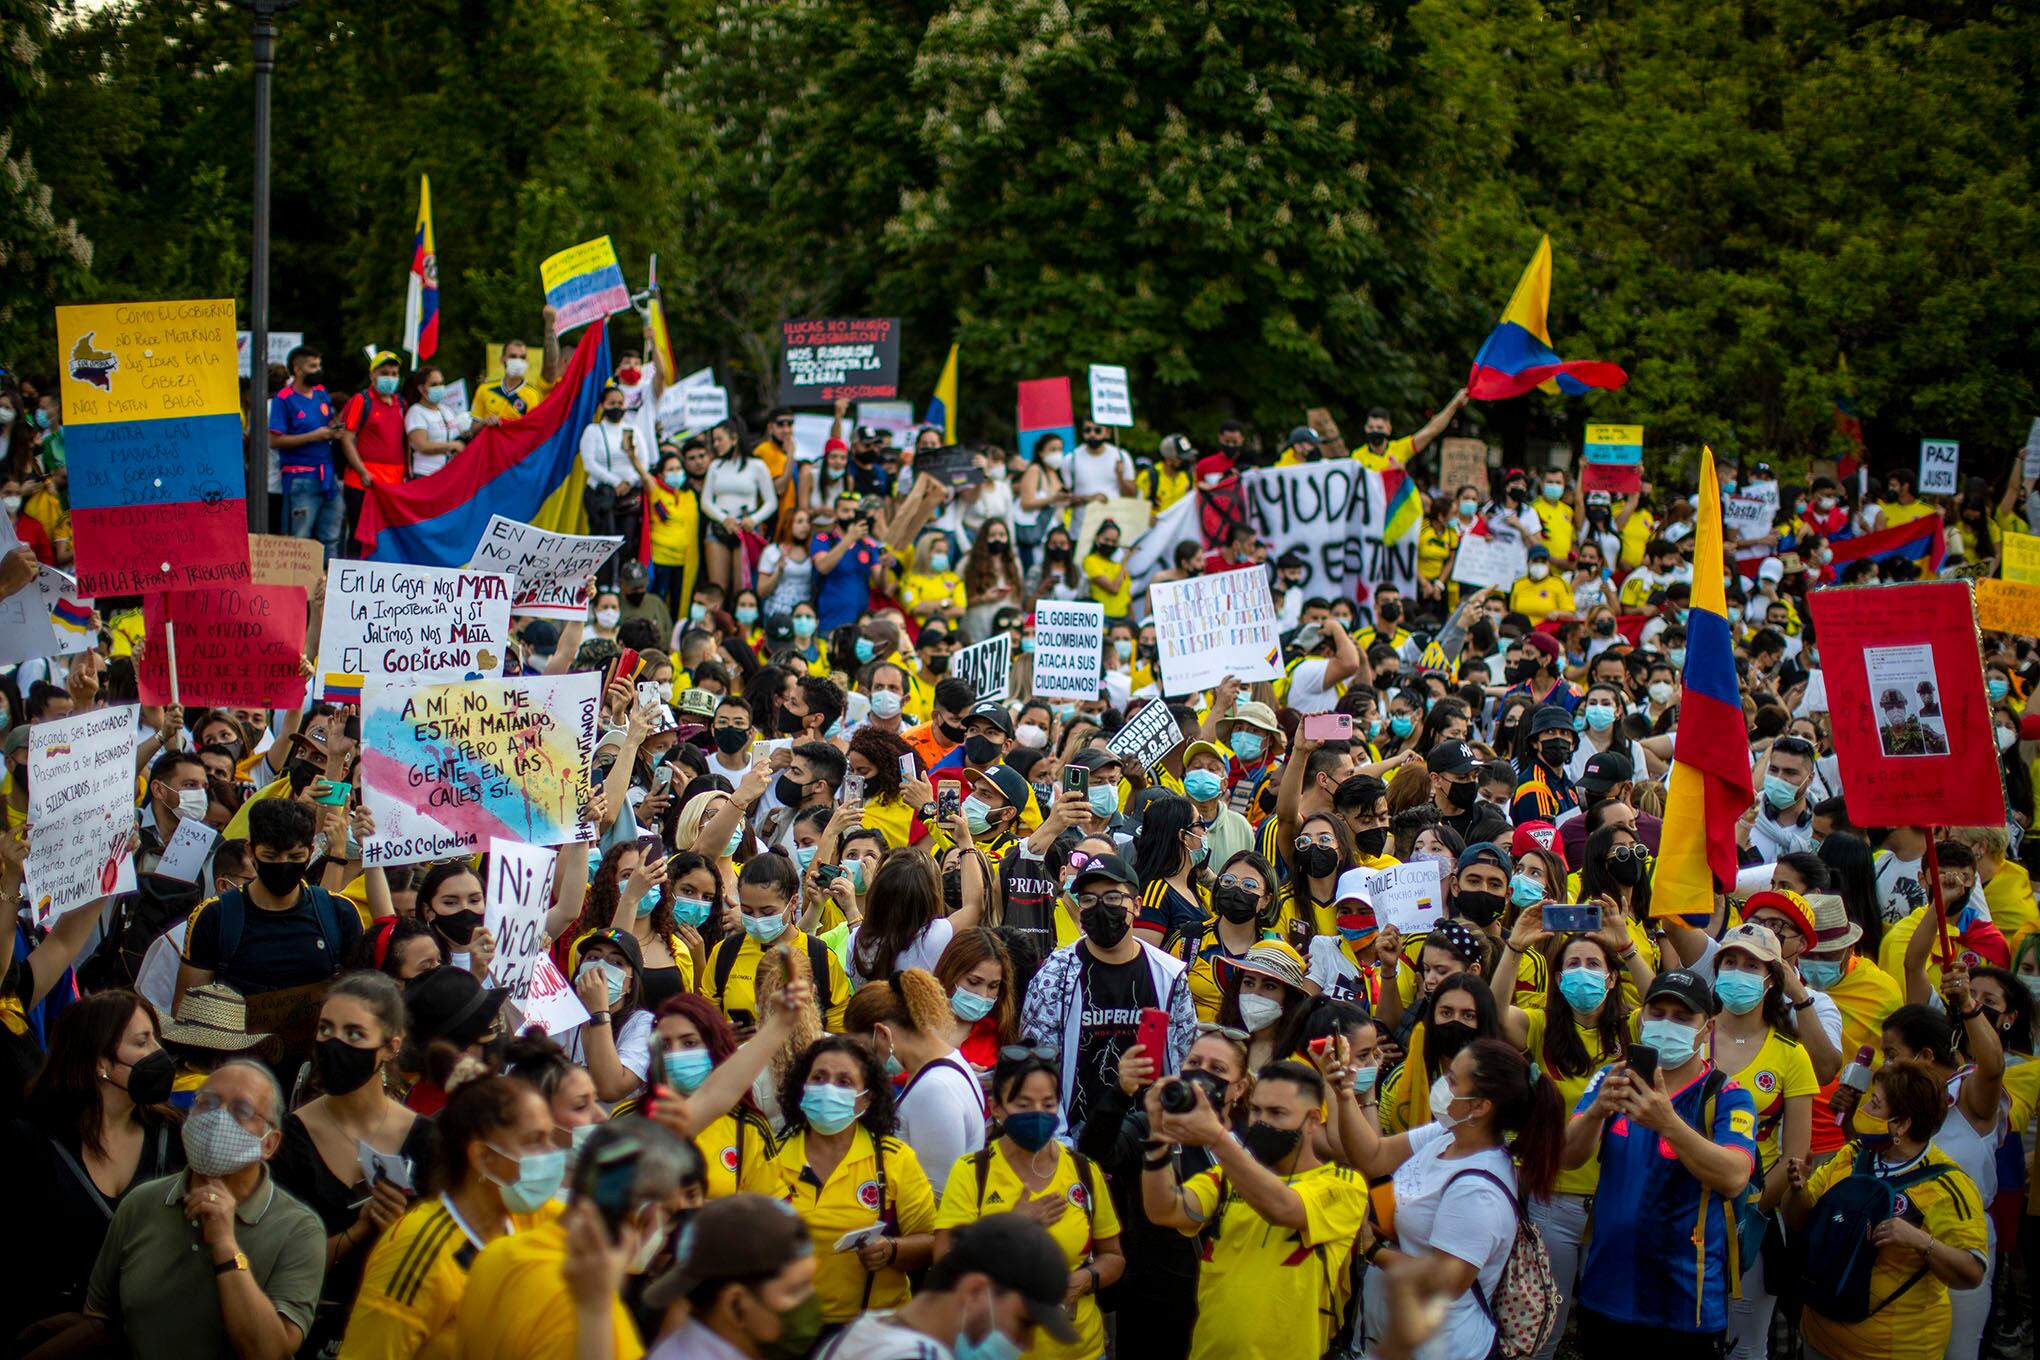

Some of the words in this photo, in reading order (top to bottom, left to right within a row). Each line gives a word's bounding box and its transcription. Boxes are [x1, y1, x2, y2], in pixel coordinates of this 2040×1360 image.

[116, 307, 154, 324] COMO
[158, 306, 176, 320] EL
[178, 304, 233, 320] GOBIERNO
[116, 333, 131, 347] NO
[165, 328, 221, 344] METERNOS
[203, 352, 220, 366] LA
[141, 374, 197, 391] CABEZA
[108, 400, 148, 413] METEN
[162, 390, 205, 410] BALAS
[94, 426, 145, 443] CONTRA
[1926, 446, 1955, 463] PAZ
[124, 465, 185, 483] GOBIERNO
[196, 463, 215, 475] DE
[1249, 466, 1371, 537] AYUDA
[492, 521, 526, 543] EN
[481, 543, 511, 561] NO
[519, 553, 550, 569] NOS
[555, 557, 593, 570] MATA
[505, 564, 526, 577] EL
[77, 574, 97, 594] NO
[98, 571, 108, 590] A
[111, 569, 128, 592] LA
[456, 575, 508, 600] MATA
[518, 578, 556, 591] MATA
[1173, 582, 1205, 602] POR
[1037, 611, 1049, 626] EL
[1050, 611, 1099, 628] GOBIERNO
[208, 622, 263, 639] MATANDO
[448, 624, 494, 645] MATA
[1037, 632, 1098, 649] COLOMBIANO
[193, 641, 226, 659] ALZO
[235, 643, 251, 656] LA
[257, 641, 285, 656] VOZ
[207, 664, 234, 679] QUE
[236, 664, 251, 678] SE
[343, 648, 369, 674] EL
[1038, 654, 1066, 669] ATACA
[1068, 655, 1076, 669] A
[1077, 655, 1096, 671] SUS
[220, 681, 239, 696] POR
[243, 682, 255, 695] EL
[264, 681, 287, 695] PAIS
[1035, 675, 1097, 692] CIUDADANOS!
[400, 698, 416, 721] A
[464, 691, 487, 712] NO
[504, 690, 530, 709] ME
[415, 717, 471, 742] ESTÁN
[481, 711, 557, 735] MATANDO,
[1110, 701, 1166, 755] GOBIERNO
[1123, 713, 1169, 755] ASESINO
[30, 728, 68, 753] Buscando
[458, 740, 498, 763] PERO
[508, 739, 520, 755] A
[33, 760, 70, 784] Pasamos
[73, 760, 80, 771] a
[408, 758, 468, 787] GENTE
[482, 761, 505, 781] EN
[514, 755, 542, 777] LAS
[45, 780, 91, 814] SILENCIADOS
[429, 784, 482, 808] CALLES
[72, 805, 105, 825] estamos
[72, 832, 85, 846] de
[70, 849, 94, 867] contra
[36, 872, 75, 895] integridad
[54, 874, 95, 907] HUMANO!
[499, 855, 532, 906] Ni
[495, 916, 519, 957] Ni
